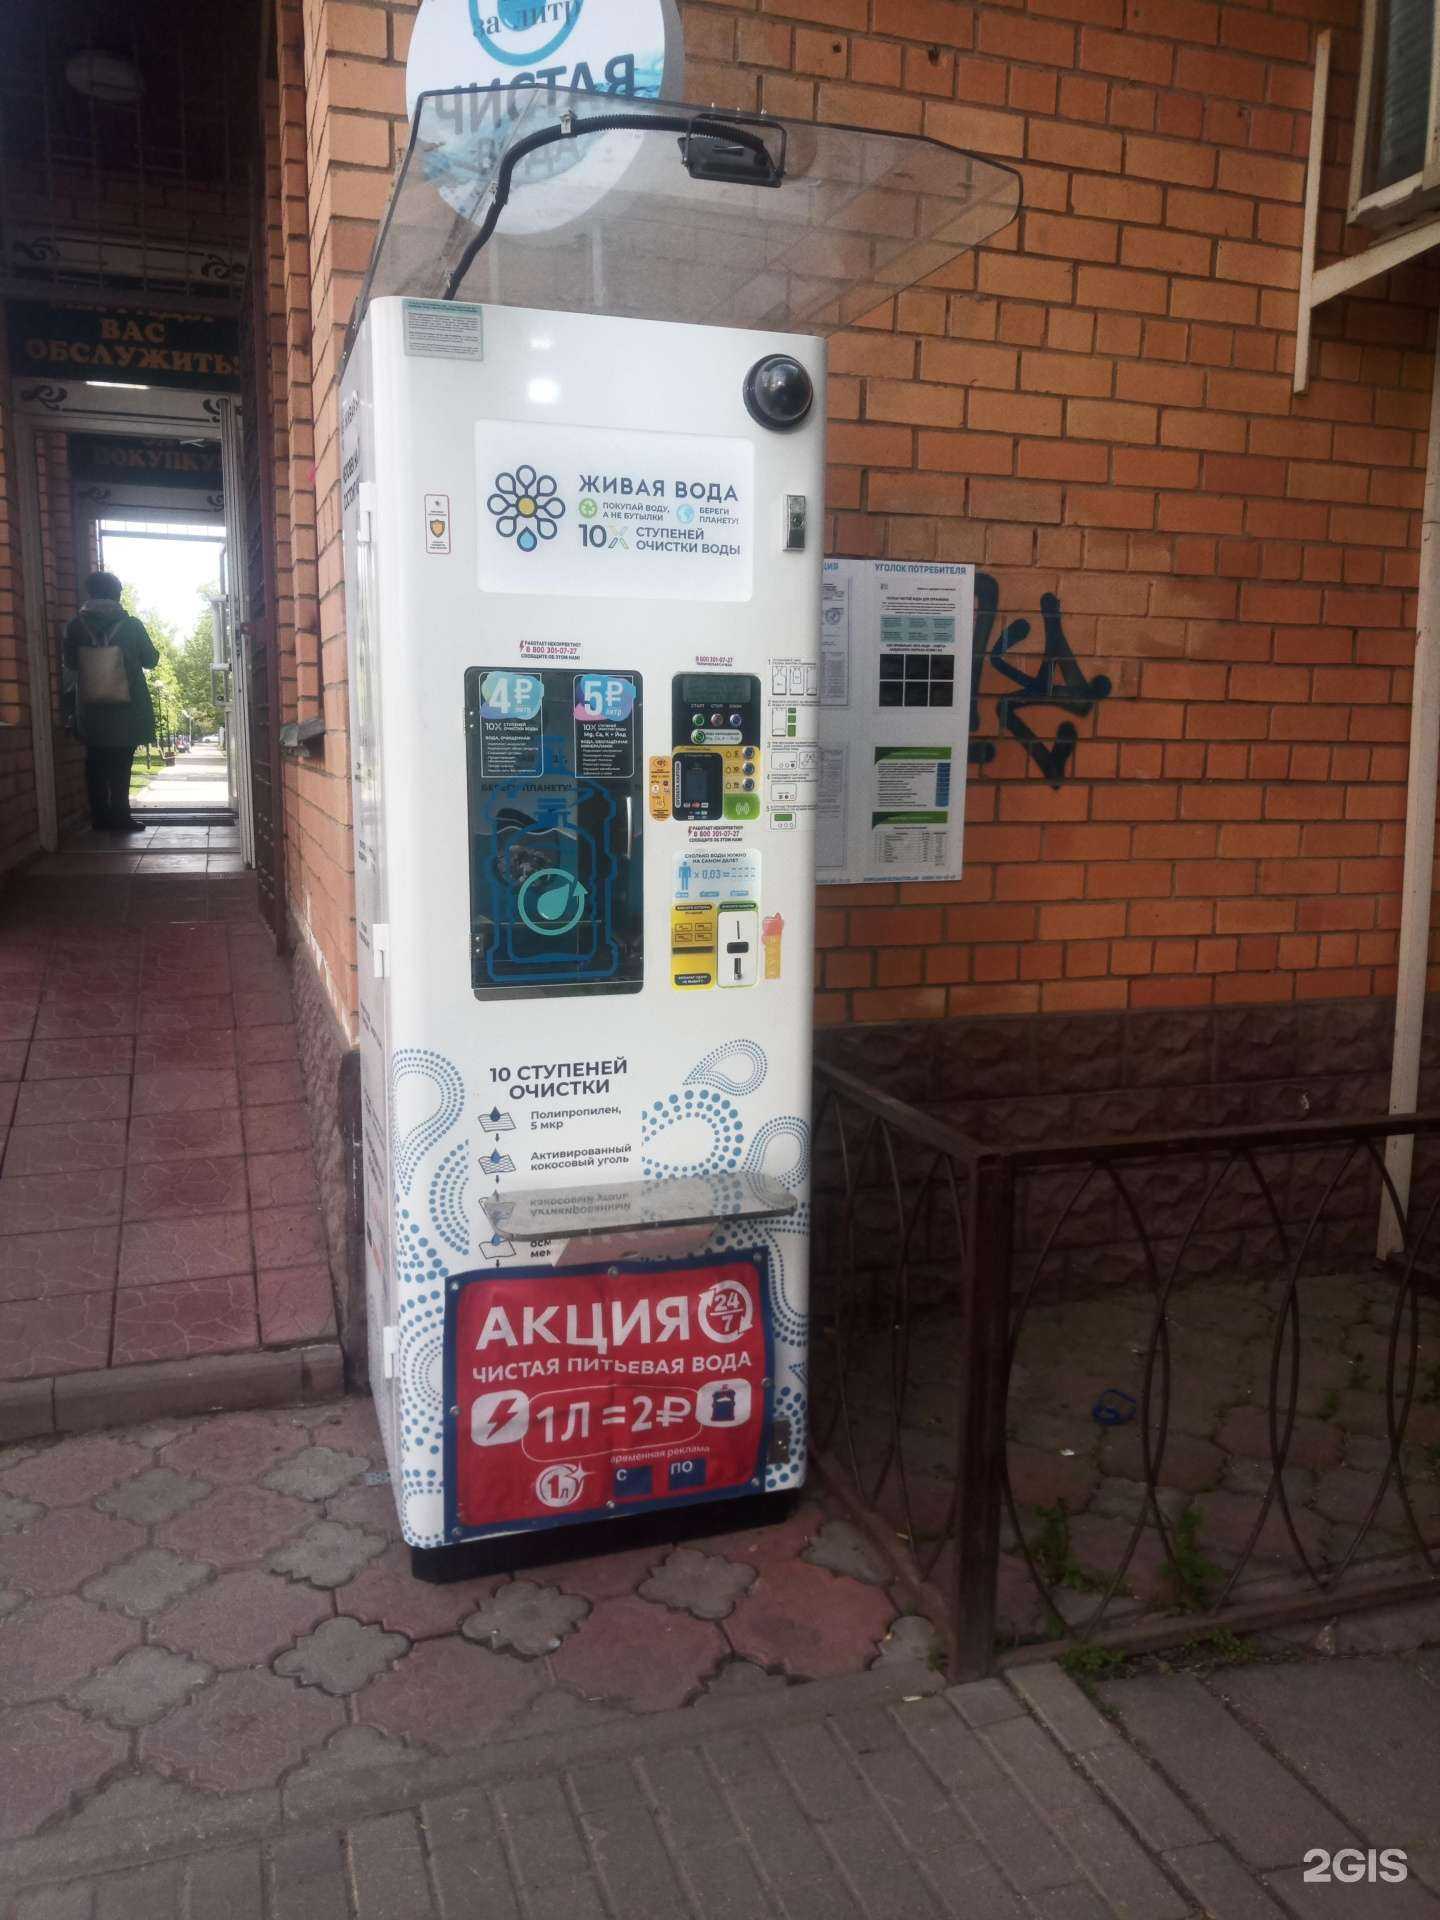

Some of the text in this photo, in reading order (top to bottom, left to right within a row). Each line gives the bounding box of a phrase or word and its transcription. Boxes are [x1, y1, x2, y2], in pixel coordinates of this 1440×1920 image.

[100, 318, 168, 343] ВАС
[578, 474, 739, 503] ЖИВАЯ ВОДА
[602, 502, 670, 513] ПОКУПАЙ ВОДУ,
[699, 507, 730, 515] БЕРЕГИ
[624, 512, 664, 521] БУТЫЛКИ
[636, 526, 705, 540] СТУПЕНЕЙ
[636, 540, 741, 556] ОЧИСТКИ ВОДЫ
[874, 563, 967, 575] УГОЛОК ПОТРЕБИТЕЛЯ
[489, 1056, 628, 1083] 10 СТУПЕНЕЙ
[509, 1079, 610, 1100] ОЧИСТКИ
[531, 1106, 622, 1121] Полипропилен,
[531, 1121, 564, 1130] 5 мкр
[531, 1144, 632, 1161] Активированный
[531, 1155, 630, 1171] кокосовый уголь
[713, 1292, 740, 1312] 24
[475, 1295, 691, 1355] АКЦИЯ
[720, 1314, 734, 1333] 7
[472, 1351, 752, 1384] ЧИСТАЯ ПИТЬЕВАЯ ВОДА
[667, 1446, 710, 1458] реклама
[616, 1468, 628, 1481] С
[671, 1460, 693, 1475] ПО
